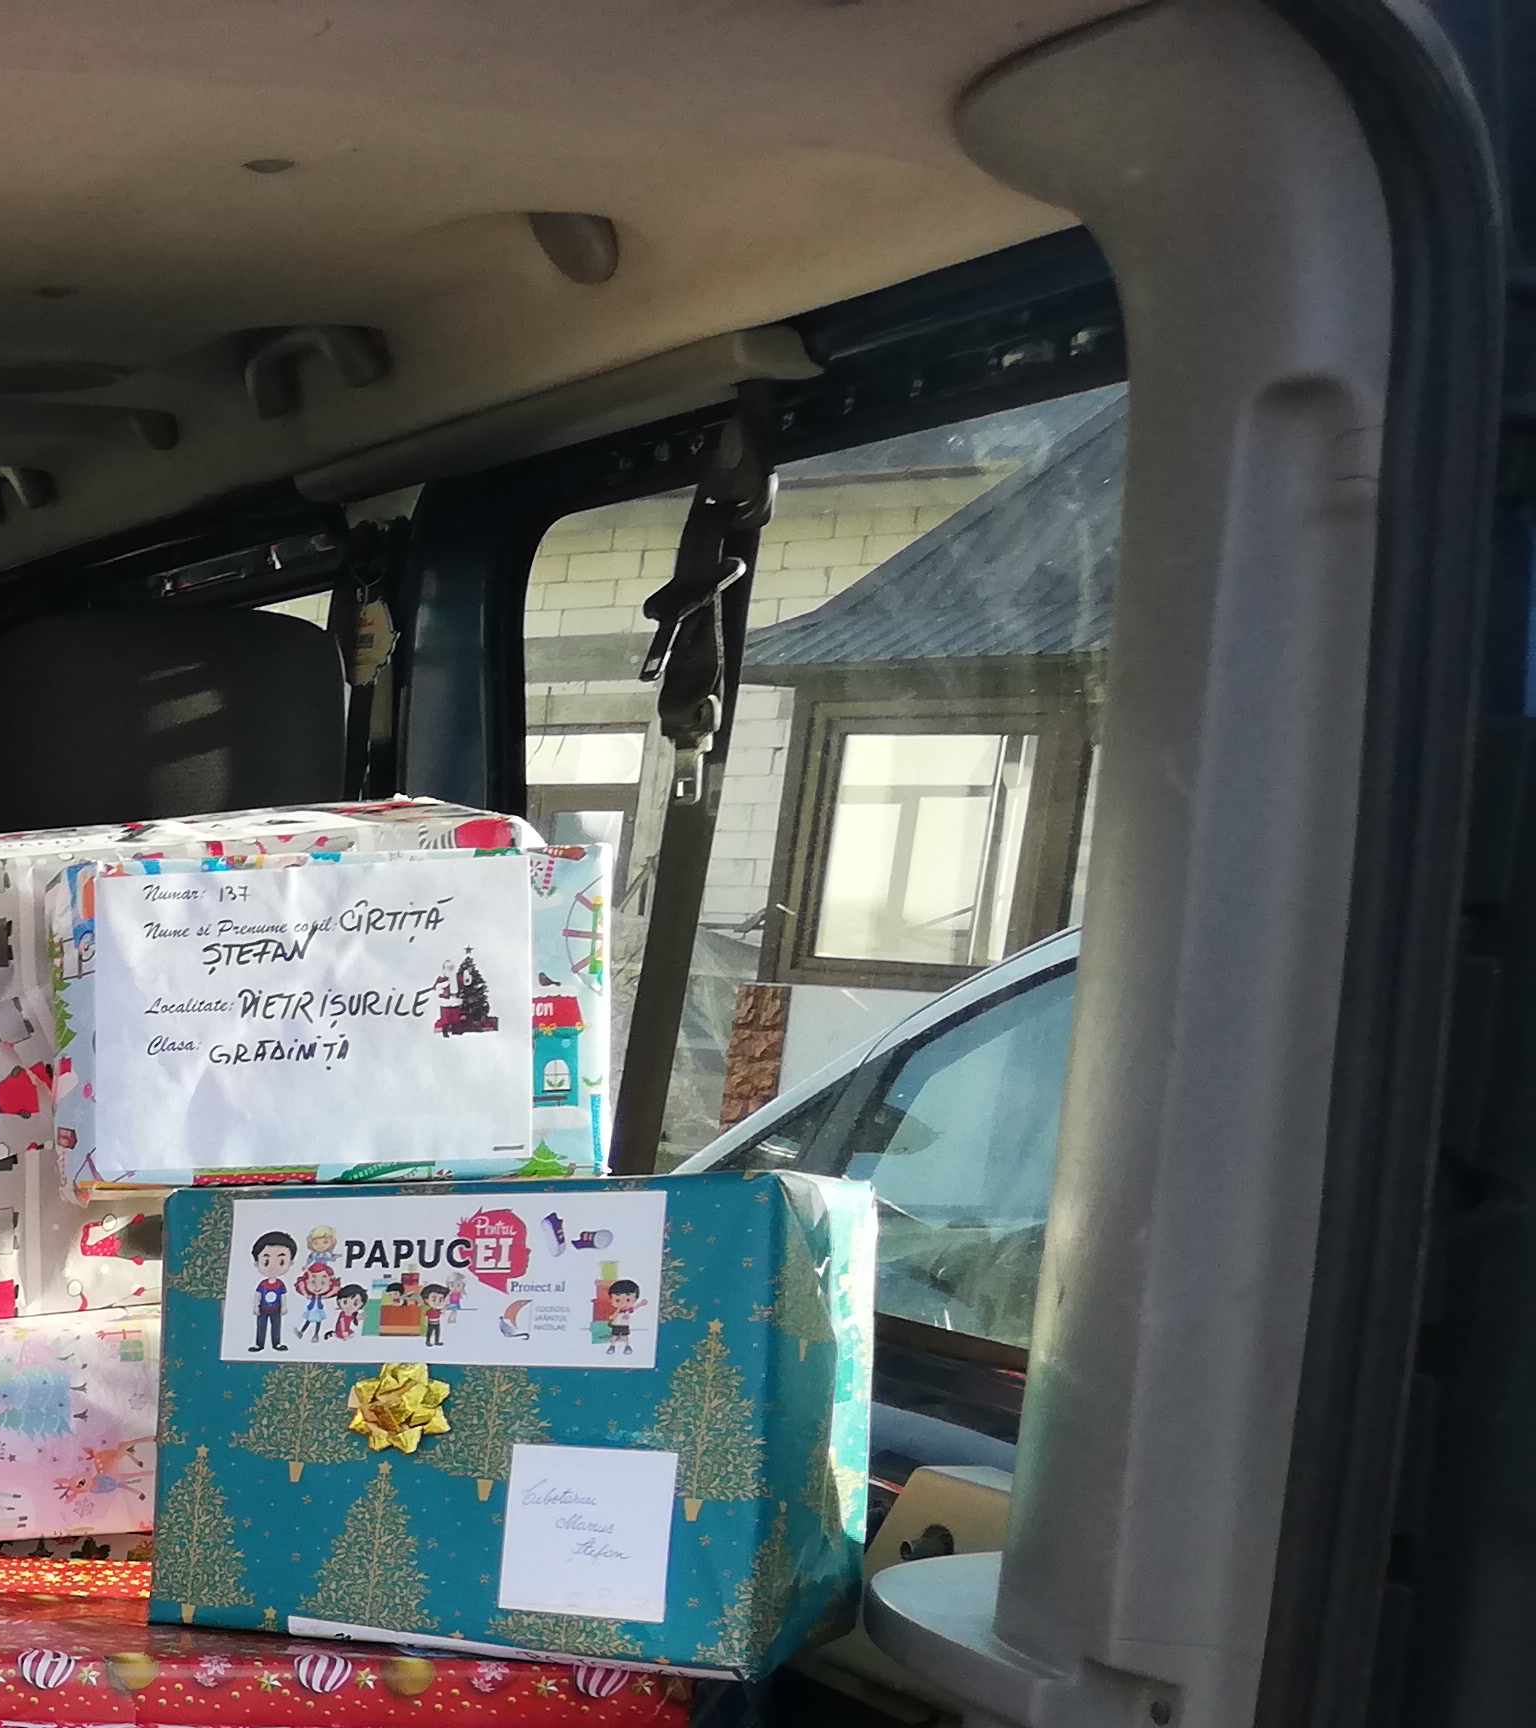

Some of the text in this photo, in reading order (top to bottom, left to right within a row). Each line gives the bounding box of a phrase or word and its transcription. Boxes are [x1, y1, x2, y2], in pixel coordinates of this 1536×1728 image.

[143, 885, 250, 902] Numar: 137
[144, 922, 190, 940] Nume
[196, 923, 212, 936] si
[217, 919, 288, 937] Prenume
[144, 997, 235, 1015] Localitate:
[147, 1035, 202, 1056] Clasa:
[344, 1237, 513, 1269] PAPUCEI
[510, 1280, 565, 1293] Proiect al
